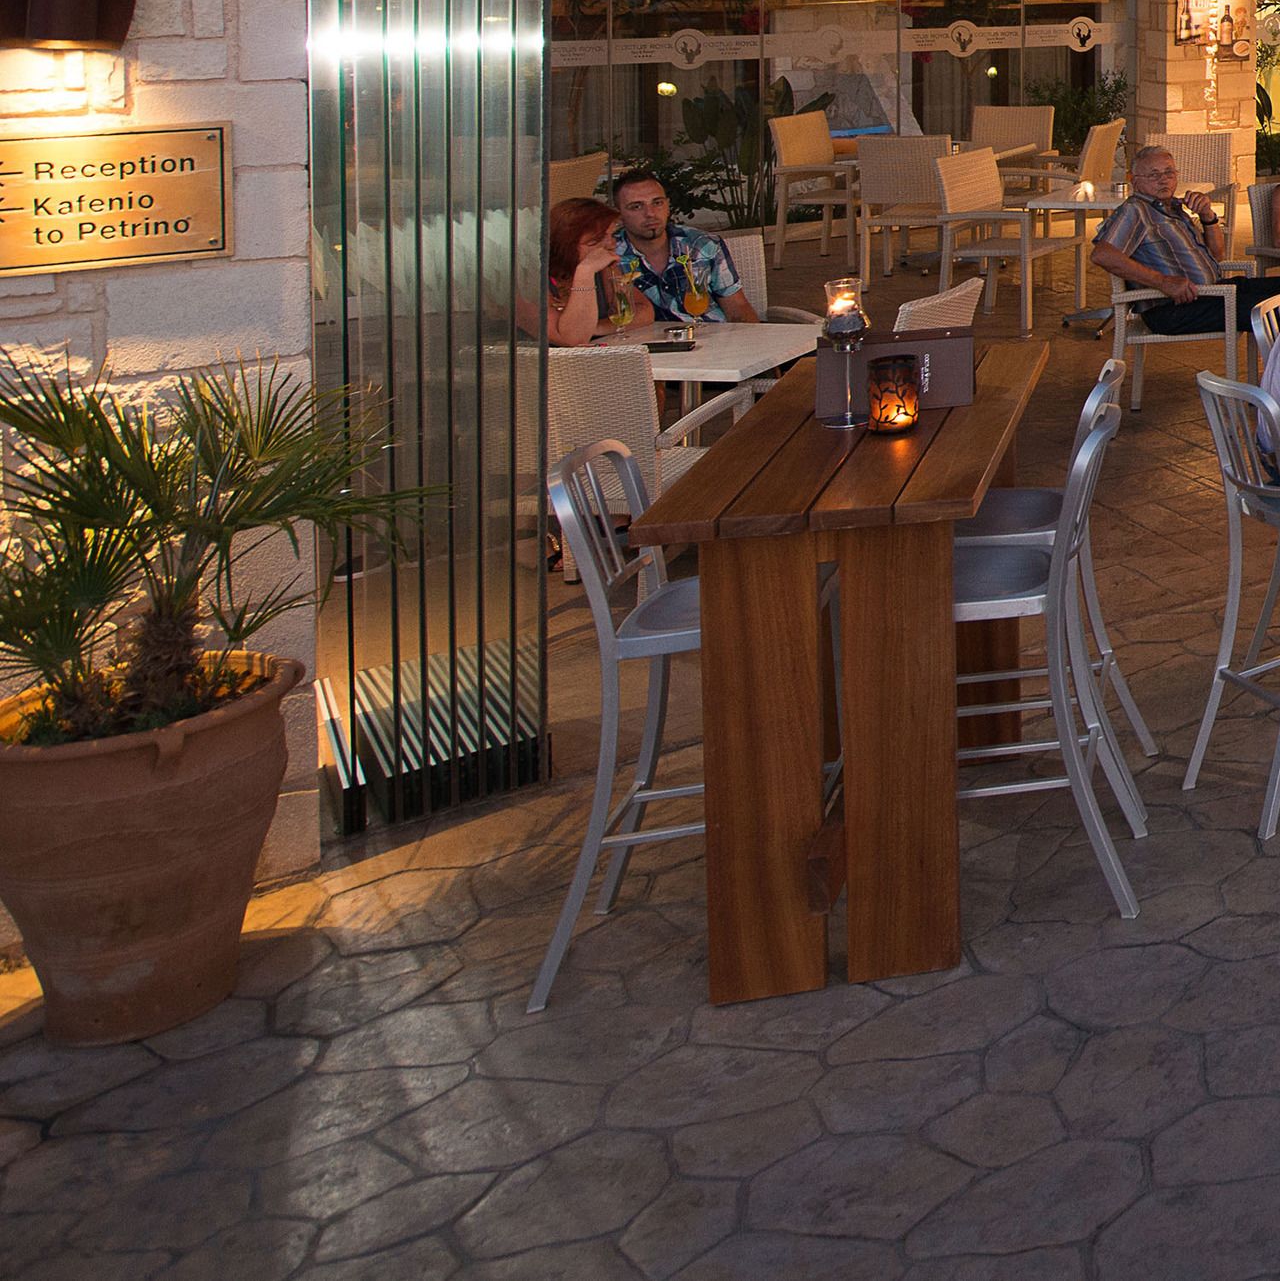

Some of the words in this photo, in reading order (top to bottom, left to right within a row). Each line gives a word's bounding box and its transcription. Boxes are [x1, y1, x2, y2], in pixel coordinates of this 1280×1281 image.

[34, 154, 196, 180] Reception
[33, 191, 155, 216] Kafenio
[33, 227, 64, 245] to
[78, 217, 191, 241] Petrino
